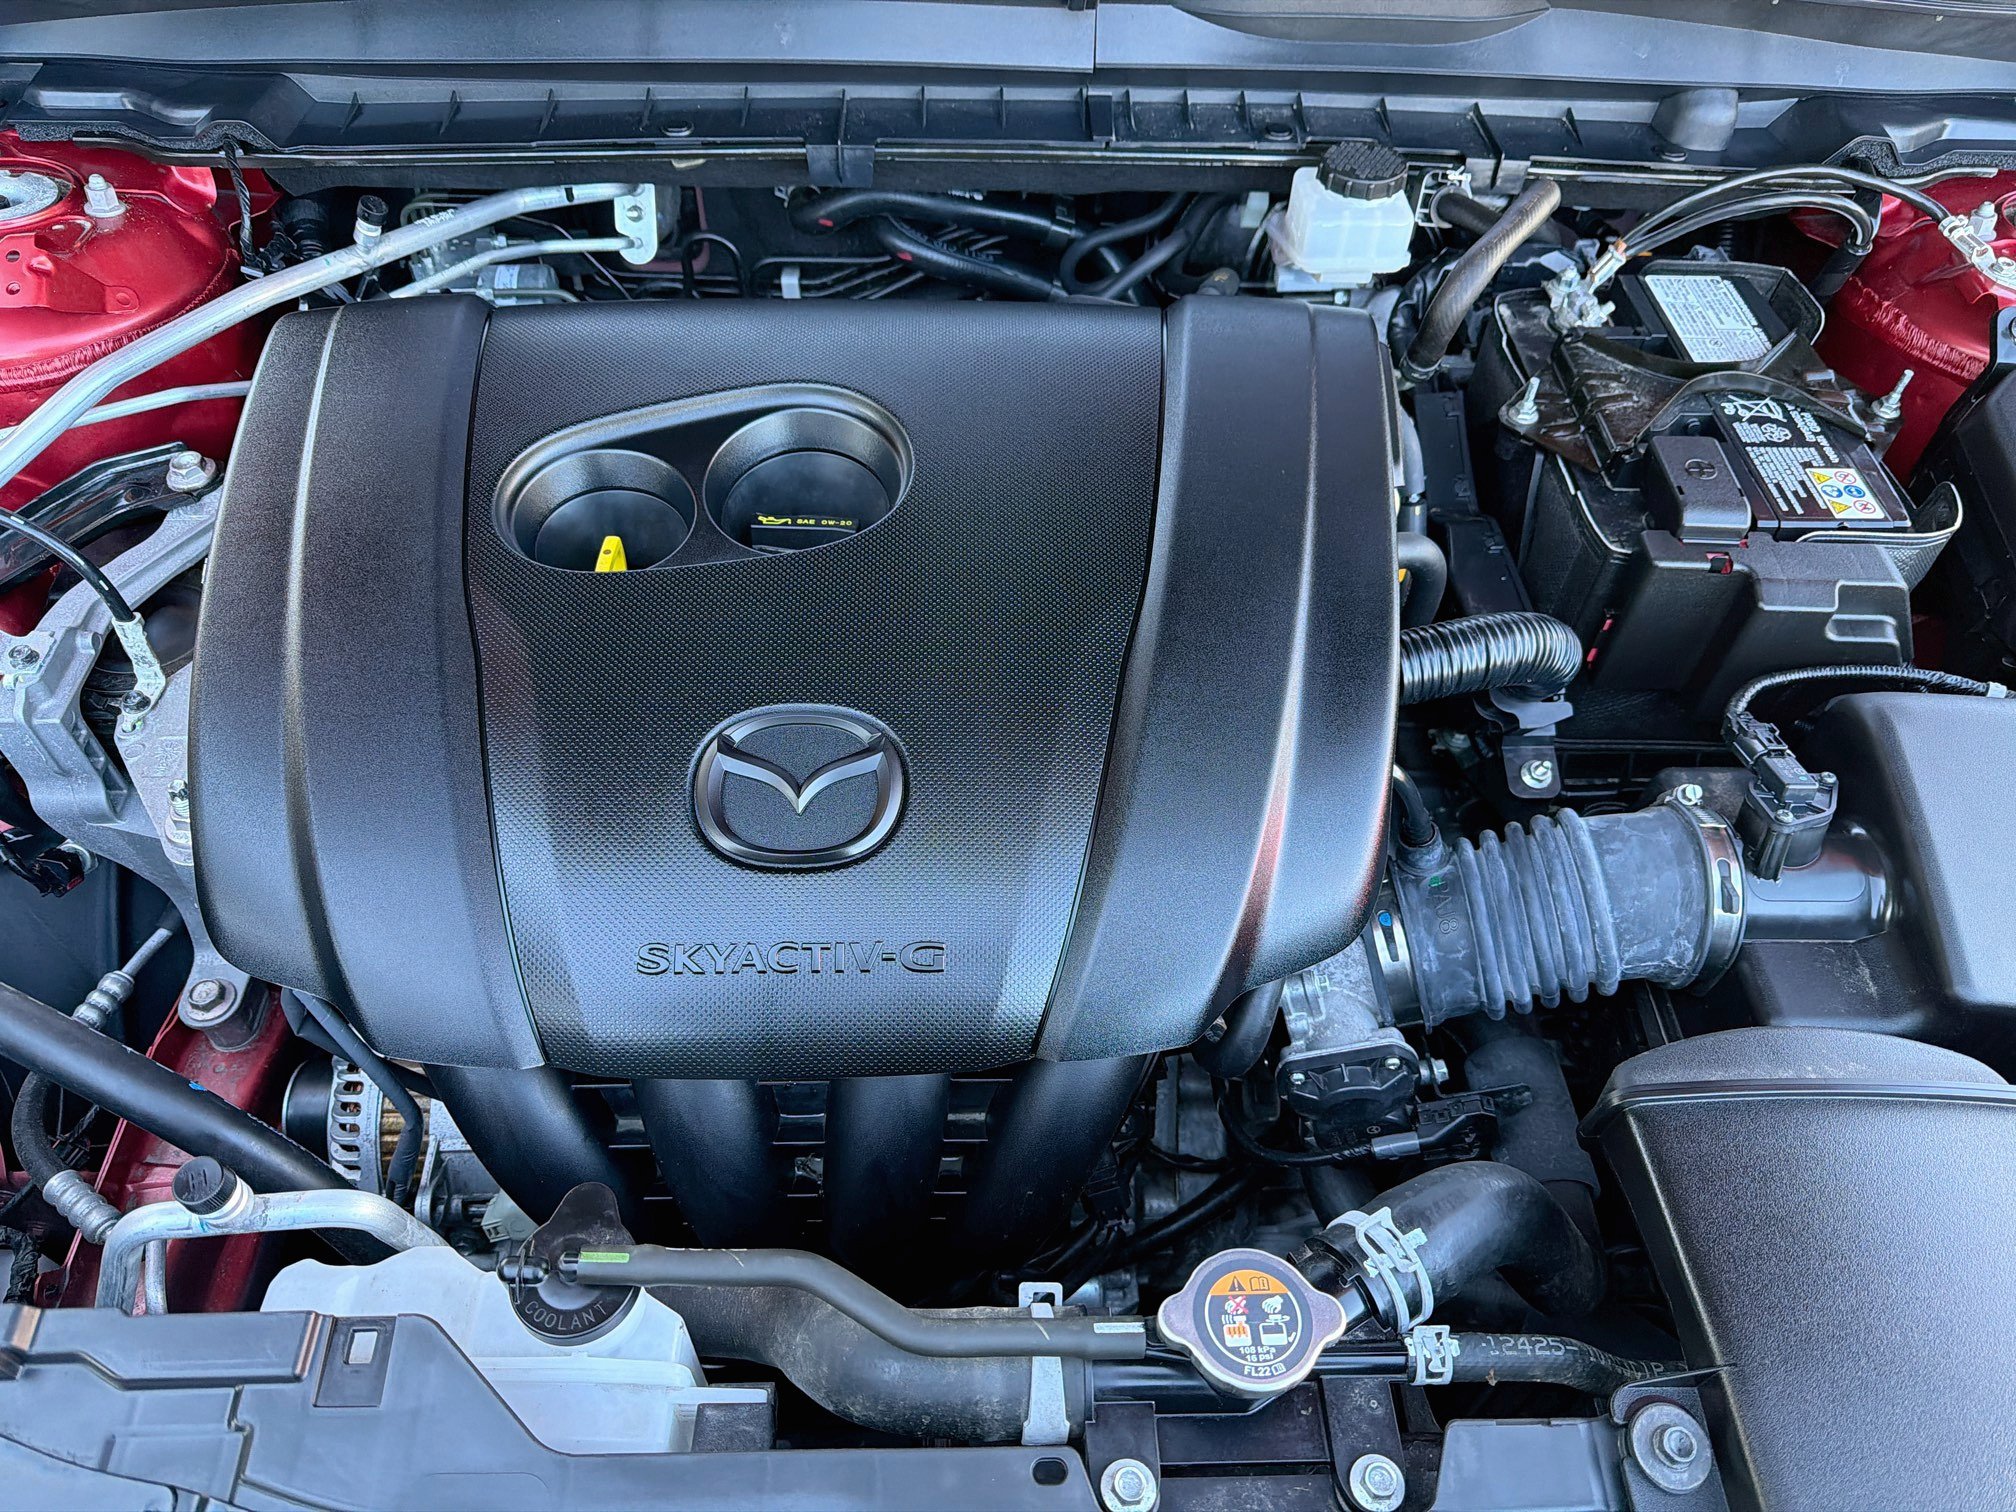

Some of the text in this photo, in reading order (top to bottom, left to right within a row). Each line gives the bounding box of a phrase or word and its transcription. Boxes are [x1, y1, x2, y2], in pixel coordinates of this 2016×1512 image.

[636, 940, 946, 975] SKYACTIV-G
[525, 1301, 608, 1331] COOLANT
[1257, 1346, 1276, 1354] kPa
[1245, 1353, 1274, 1362] 16 psi
[1244, 1365, 1271, 1377] FL22
